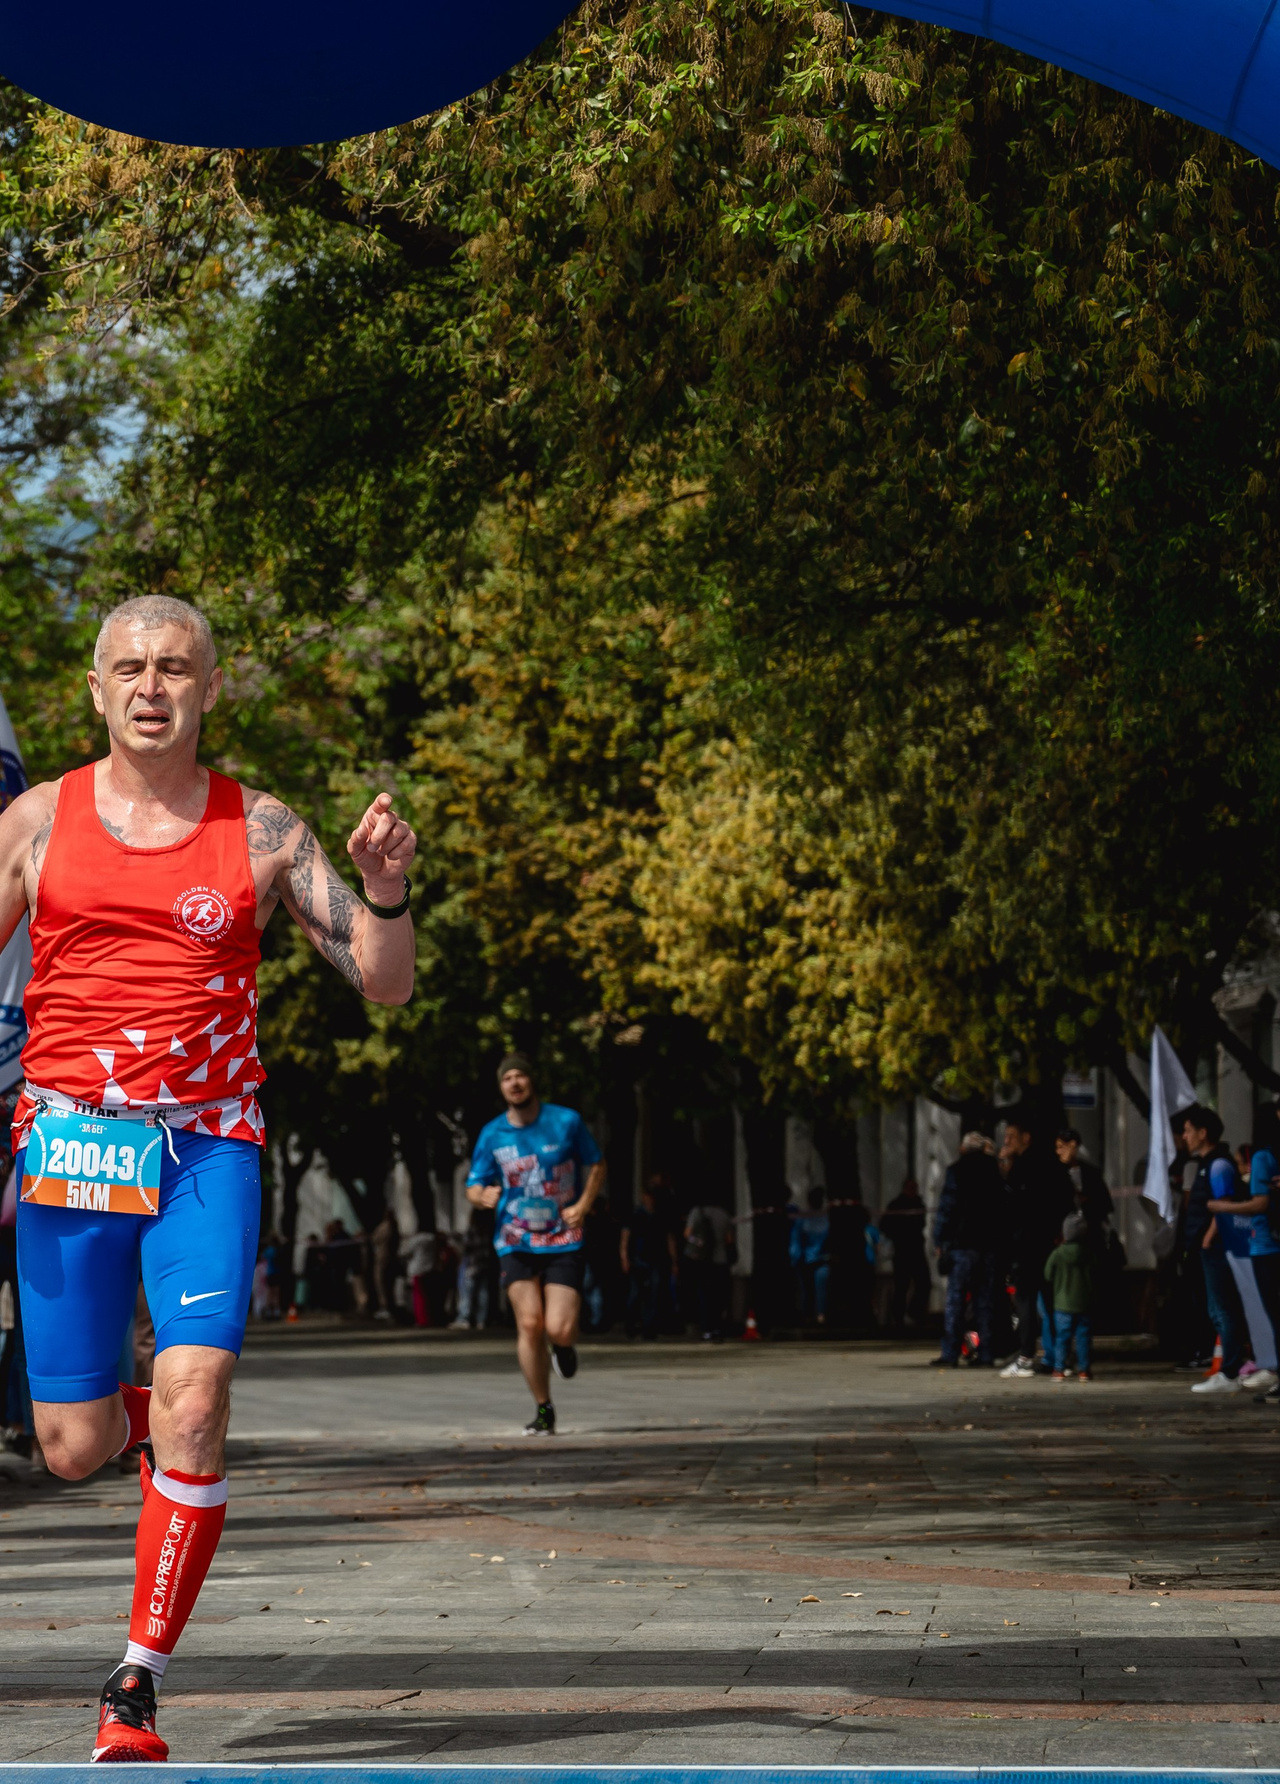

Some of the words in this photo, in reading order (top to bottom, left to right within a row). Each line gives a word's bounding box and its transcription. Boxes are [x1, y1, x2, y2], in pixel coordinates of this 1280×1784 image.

[176, 886, 209, 903] GOLDEN
[210, 888, 229, 906] RING
[176, 924, 201, 943] ULTRA
[205, 929, 228, 943] TRAIL
[52, 1109, 69, 1118] ПСБ
[73, 1101, 118, 1118] TITAN
[47, 1137, 136, 1181] 20043
